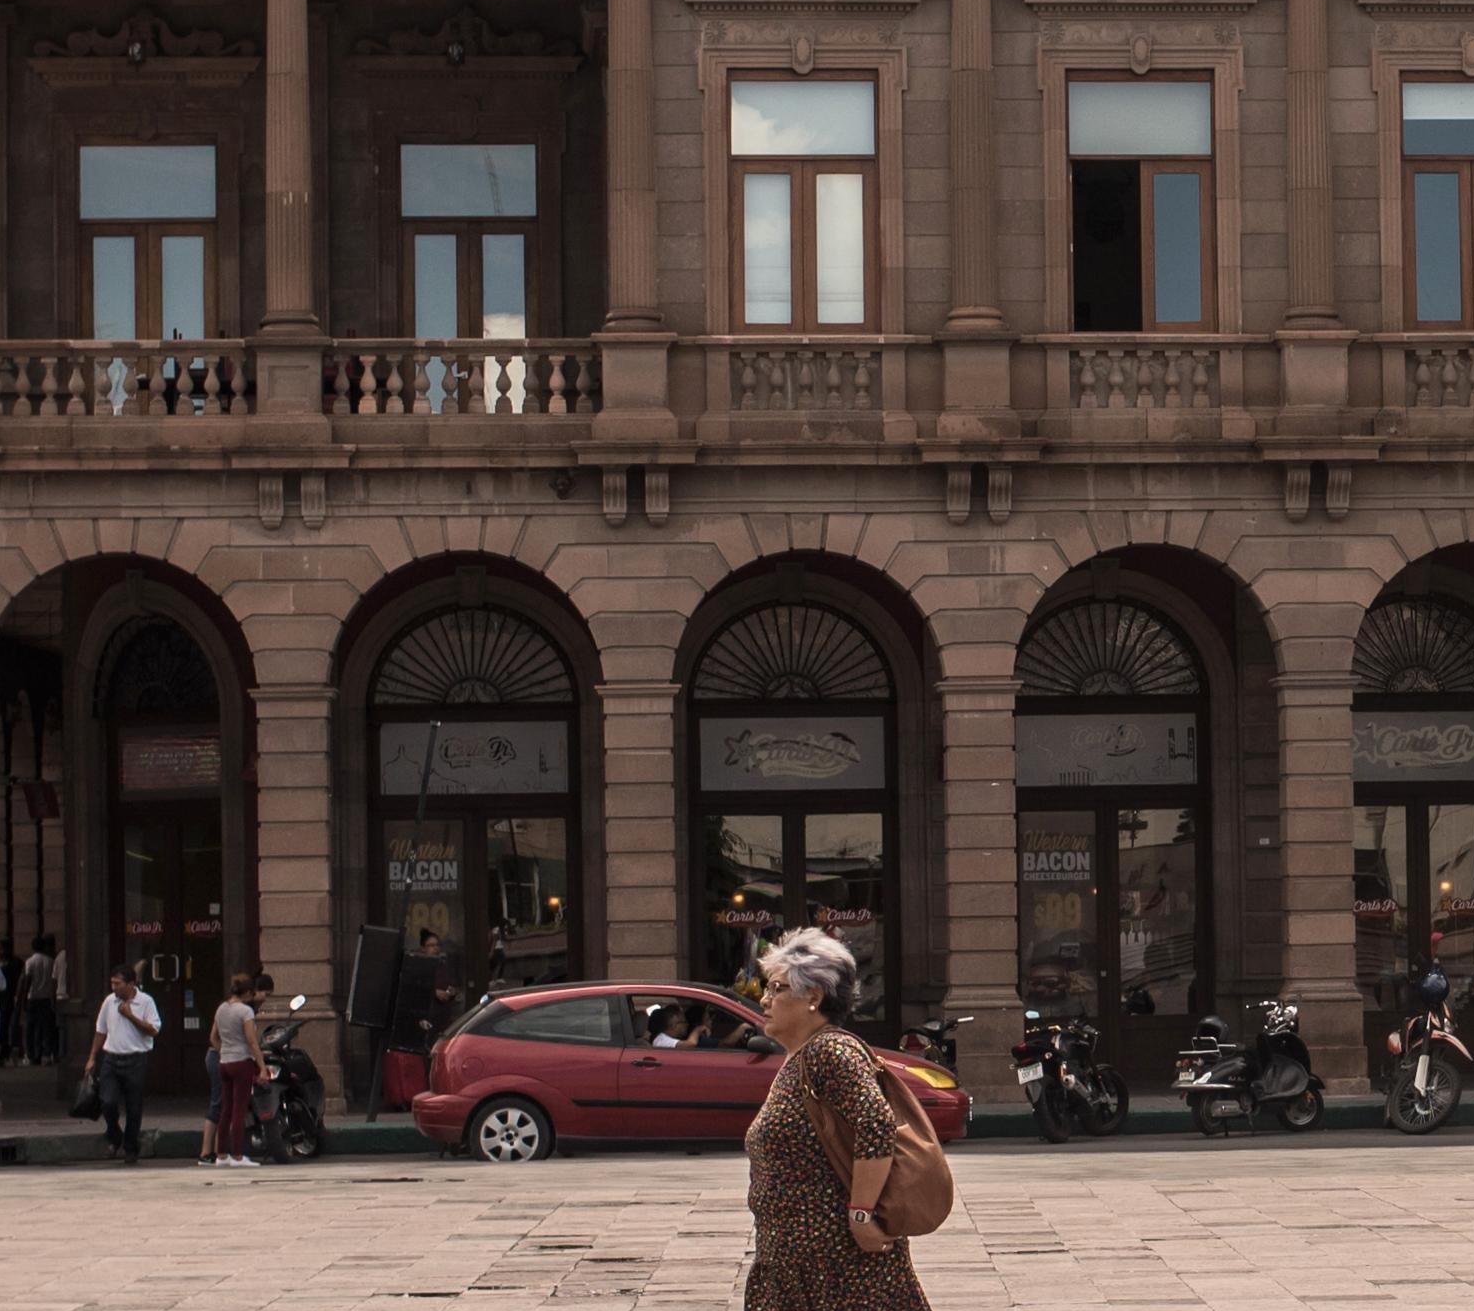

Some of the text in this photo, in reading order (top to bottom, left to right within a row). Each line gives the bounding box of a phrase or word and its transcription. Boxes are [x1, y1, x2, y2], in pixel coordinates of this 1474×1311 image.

[389, 838, 455, 860] Wstern
[1025, 830, 1089, 851] Western
[1022, 851, 1091, 872] BACON
[1022, 871, 1091, 881] CHEESEBURGER
